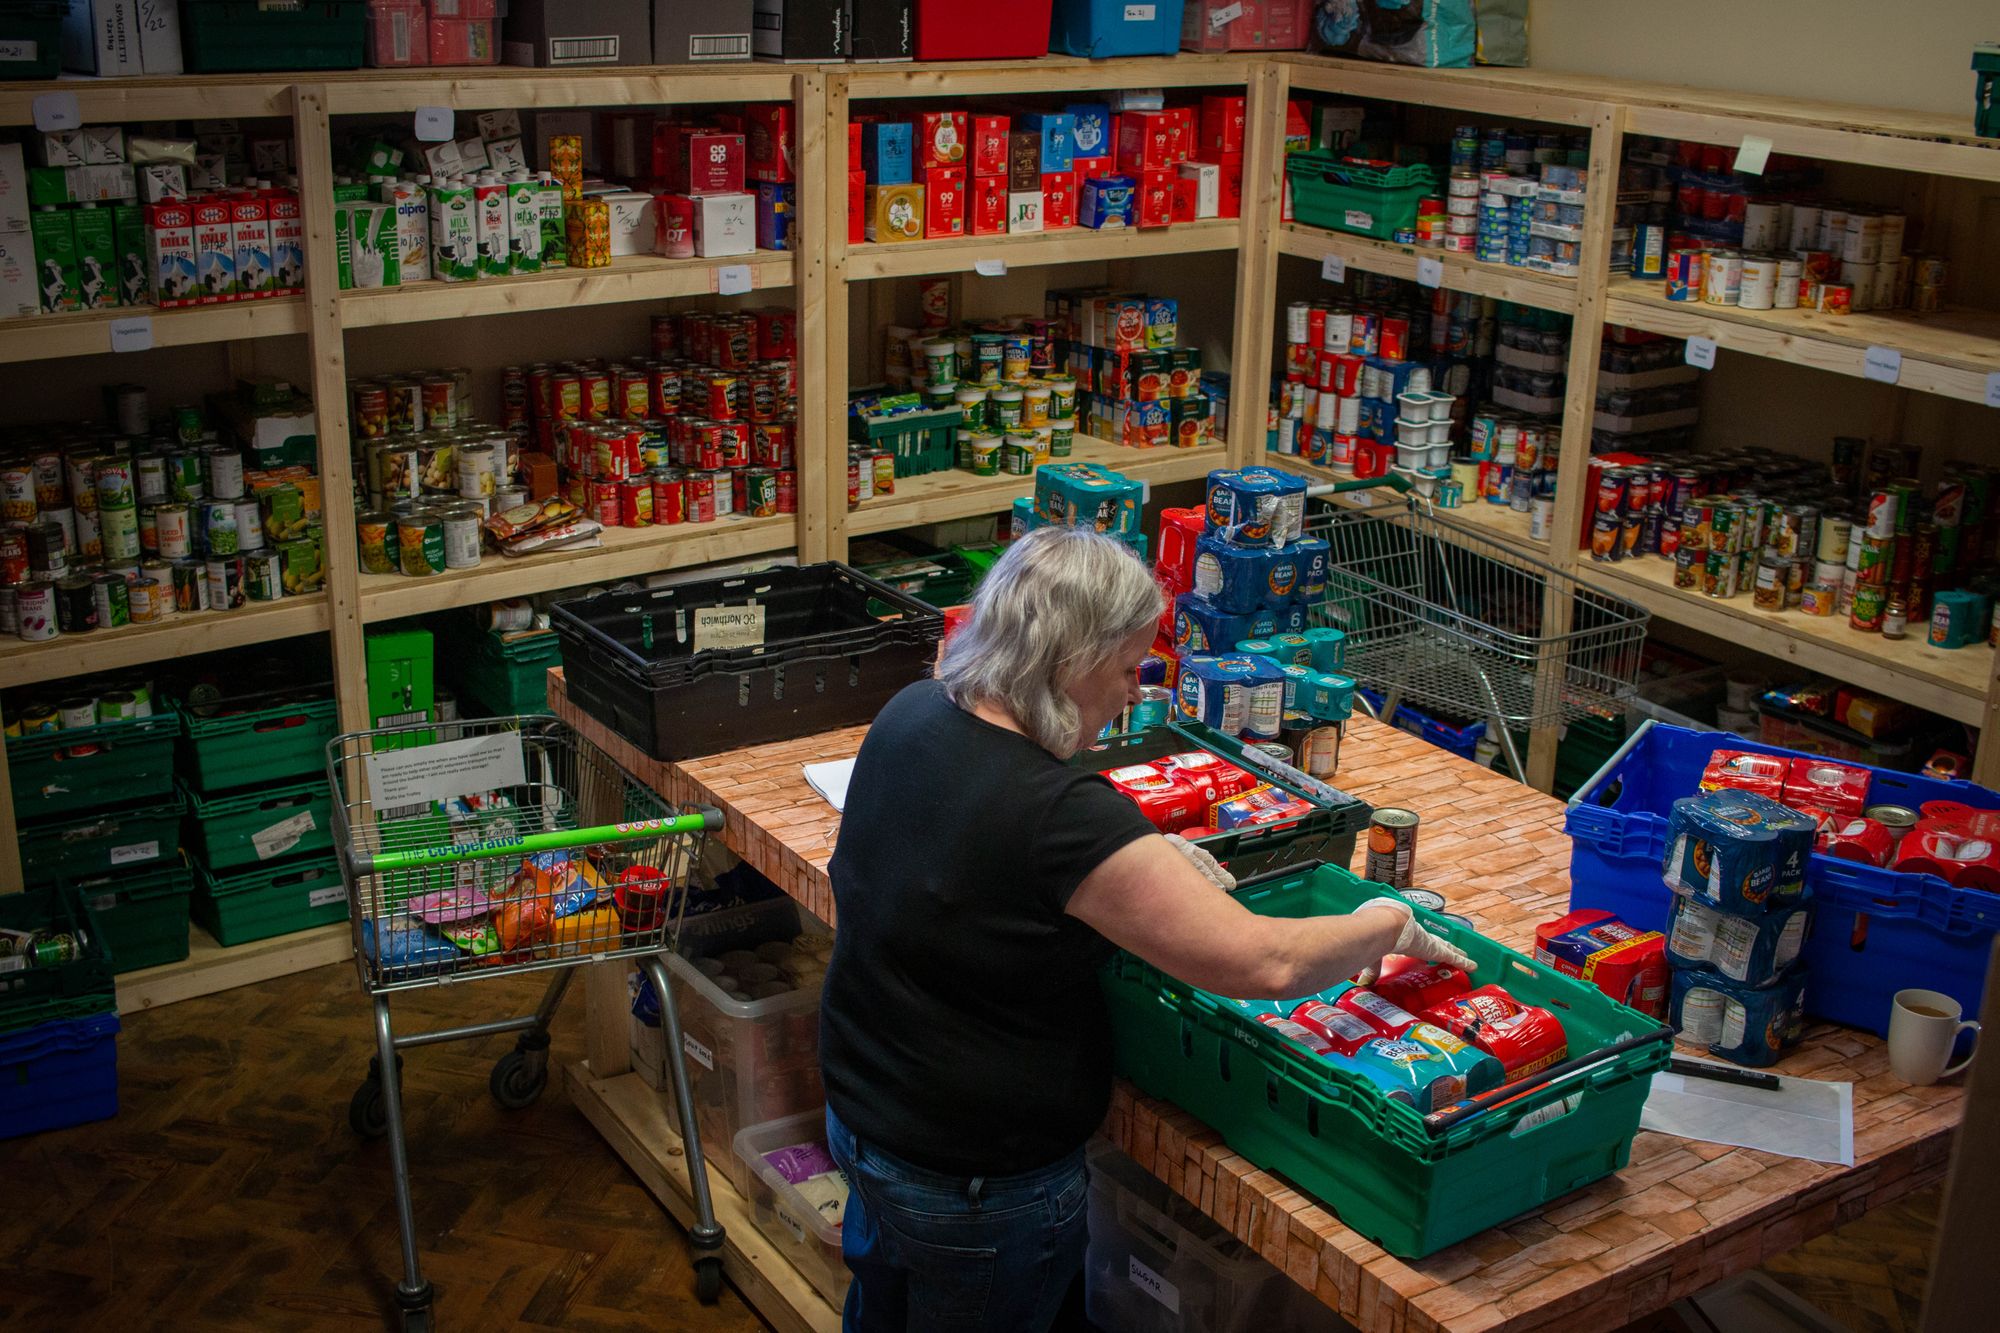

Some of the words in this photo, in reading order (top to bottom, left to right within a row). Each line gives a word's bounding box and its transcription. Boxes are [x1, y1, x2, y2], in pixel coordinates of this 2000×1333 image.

[115, 3, 127, 63] SPAGHETTI
[940, 192, 954, 202] 99
[398, 203, 426, 217] alpro
[160, 236, 189, 248] MILK
[200, 232, 228, 244] MILK
[237, 229, 265, 241] MILK
[336, 228, 350, 264] milk
[380, 225, 399, 261] milk
[1312, 555, 1323, 570] 6
[701, 615, 741, 627] Northwich
[744, 614, 755, 625] DC
[1290, 612, 1301, 626] 6
[428, 834, 525, 858] co-operative
[1786, 850, 1799, 868] 4
[1782, 869, 1802, 877] PACK
[1234, 1027, 1259, 1048] IFCO
[1386, 1045, 1420, 1058] BEANZ
[1131, 1263, 1162, 1294] SUGAR
